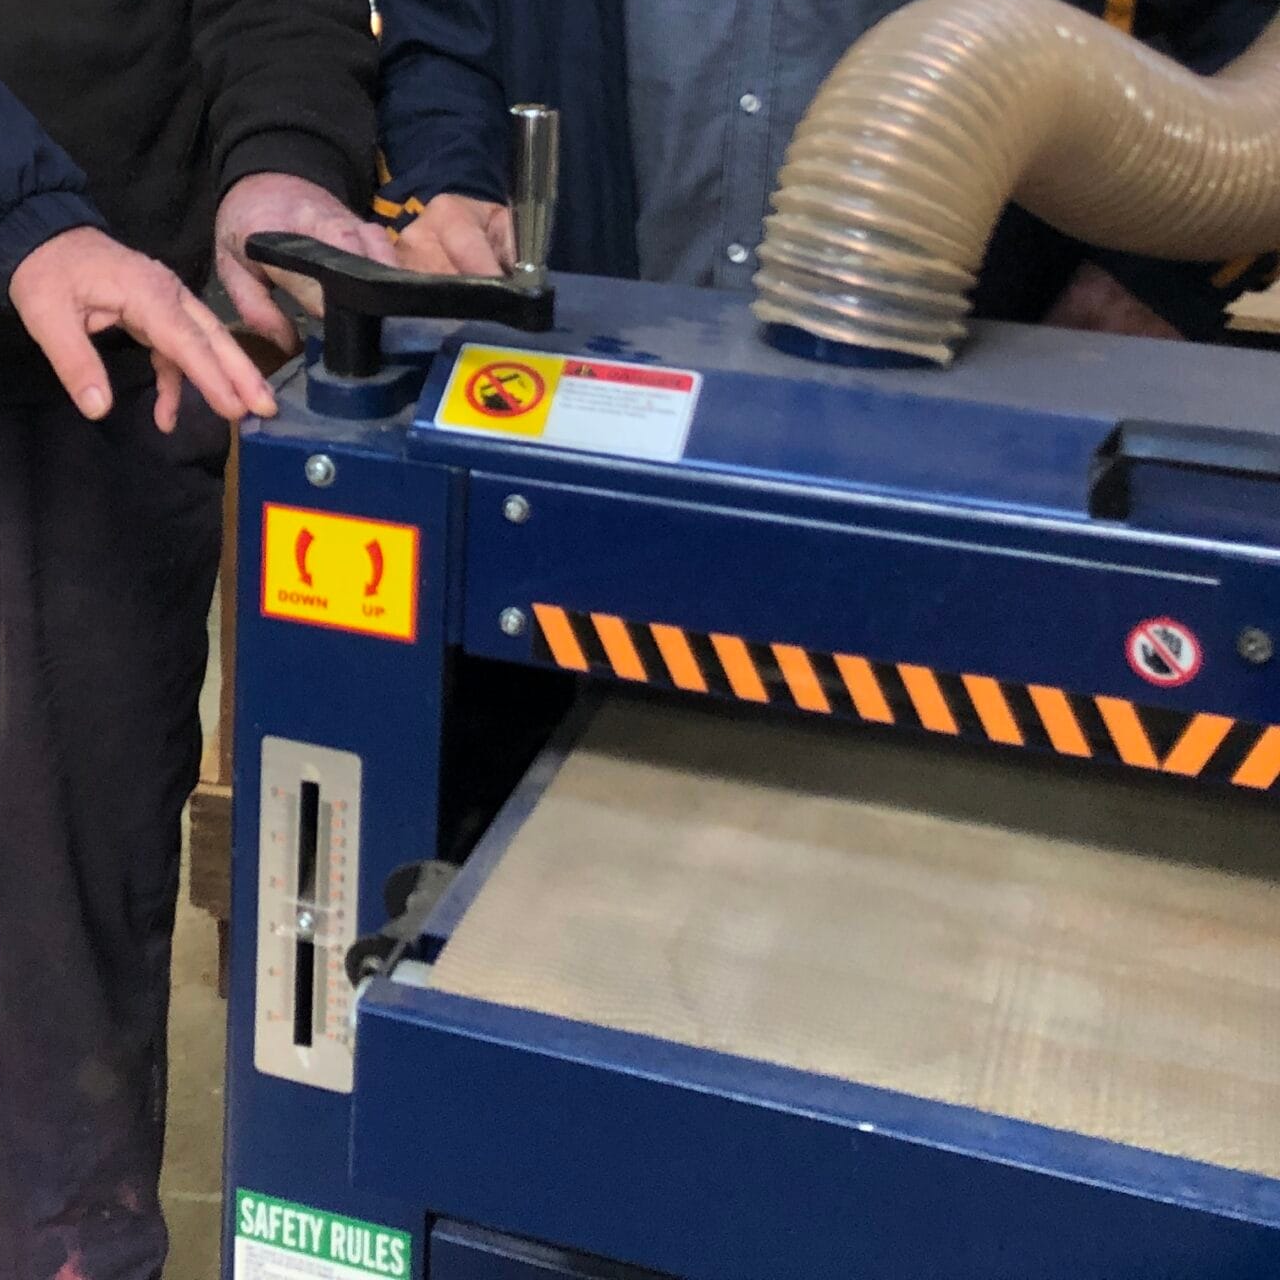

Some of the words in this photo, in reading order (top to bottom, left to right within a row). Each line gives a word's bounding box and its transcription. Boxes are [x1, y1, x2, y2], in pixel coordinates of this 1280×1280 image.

[277, 589, 329, 610] DOWN
[362, 603, 386, 618] UP
[240, 1196, 324, 1254] SAFETY
[329, 1220, 405, 1276] RULES
